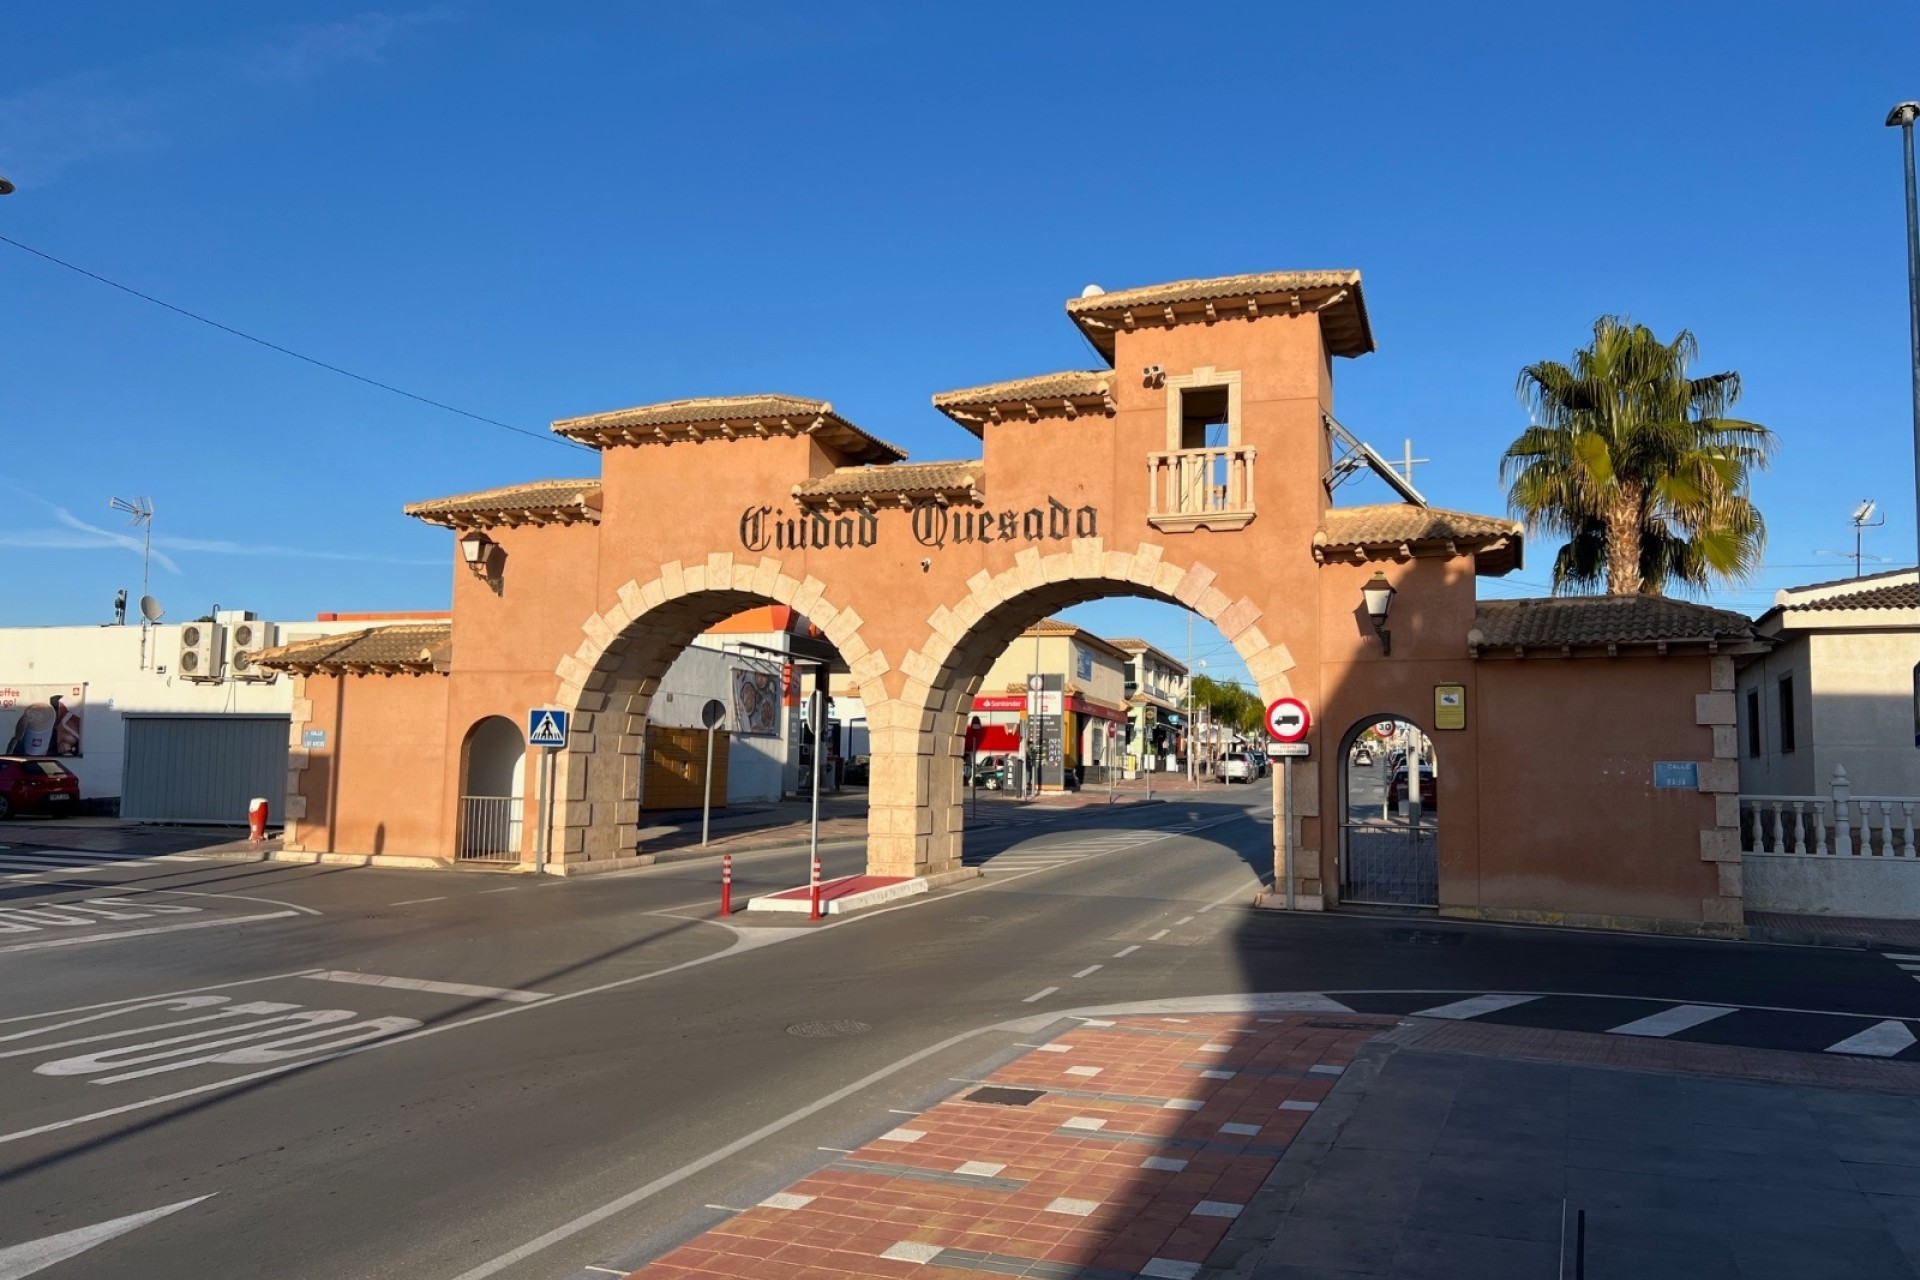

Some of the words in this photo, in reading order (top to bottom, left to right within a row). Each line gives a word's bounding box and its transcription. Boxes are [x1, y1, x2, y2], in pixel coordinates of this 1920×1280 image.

[739, 503, 878, 552] Ciudad
[912, 495, 1098, 551] Quesada
[990, 700, 1022, 708] Santander
[1379, 723, 1391, 731] 30
[1666, 778, 1686, 786] BAJA
